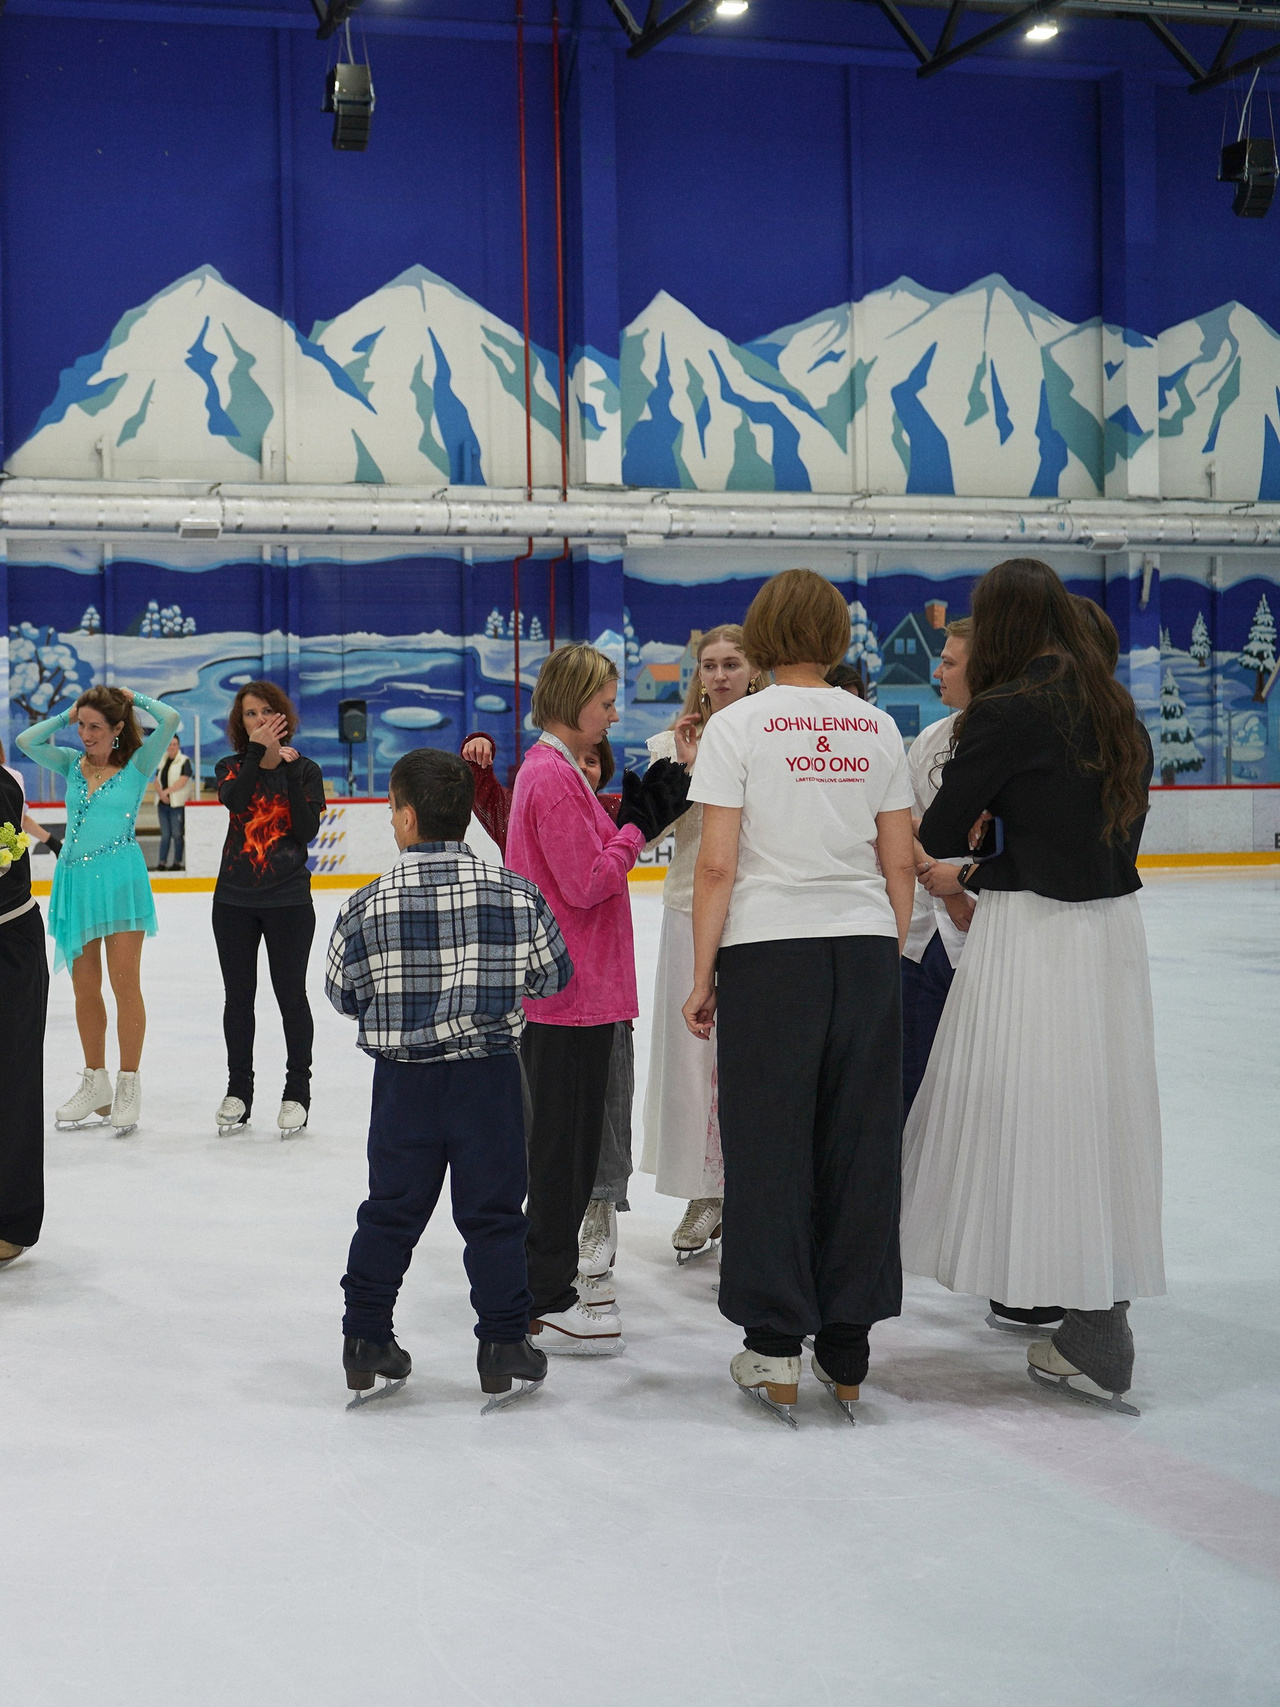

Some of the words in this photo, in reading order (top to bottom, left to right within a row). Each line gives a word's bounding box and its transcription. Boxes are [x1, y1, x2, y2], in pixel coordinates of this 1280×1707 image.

[816, 736, 832, 752] &
[785, 756, 826, 772] YOO
[829, 757, 869, 772] ONO
